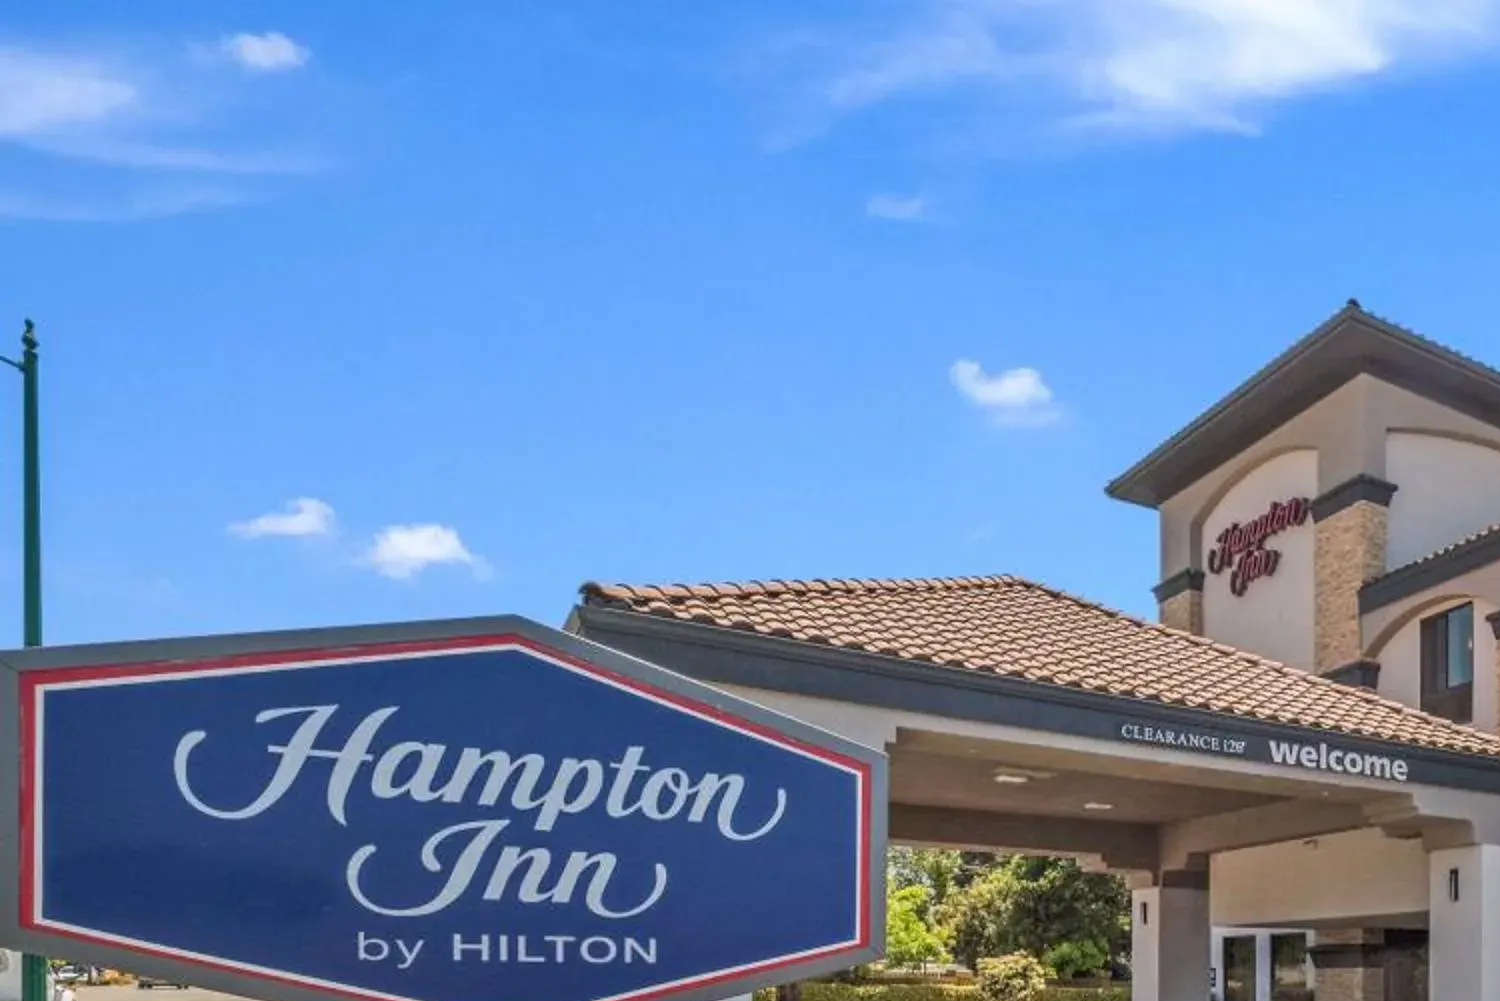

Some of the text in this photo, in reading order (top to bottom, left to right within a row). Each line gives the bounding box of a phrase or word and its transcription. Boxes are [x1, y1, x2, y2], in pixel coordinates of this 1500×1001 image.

[1121, 724, 1220, 752] CLEARANCE
[174, 704, 786, 841] Hampton
[346, 819, 667, 918] Inn
[358, 932, 657, 969] by HILTON
